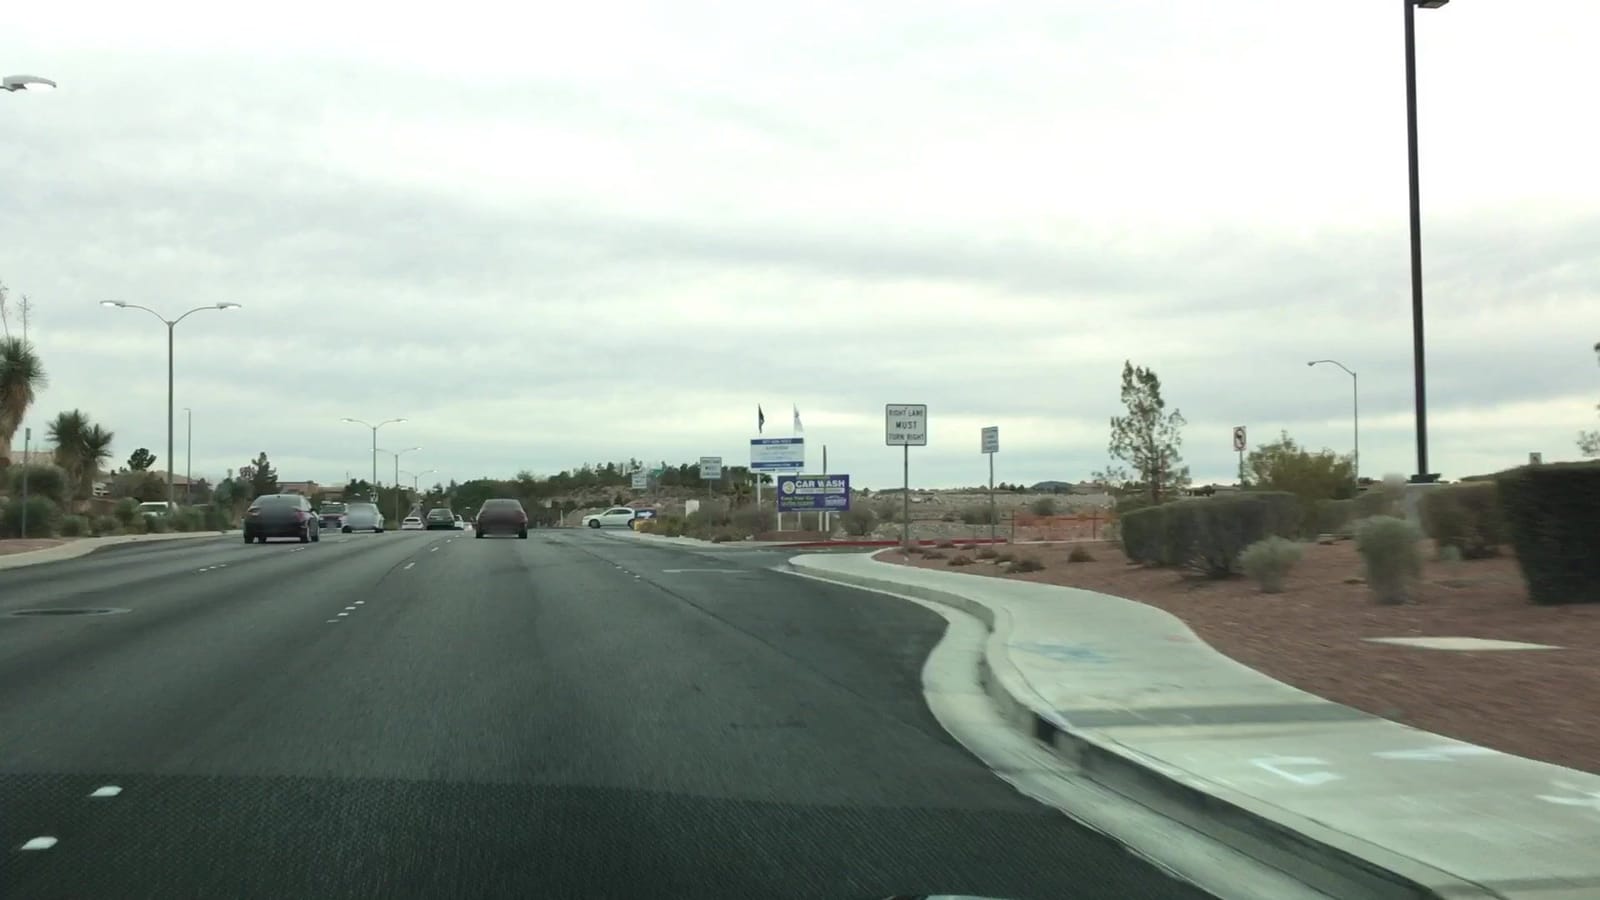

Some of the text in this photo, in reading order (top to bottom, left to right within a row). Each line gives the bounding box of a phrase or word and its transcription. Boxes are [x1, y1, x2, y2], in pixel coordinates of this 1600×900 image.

[889, 409, 923, 417] RIGHT LANE
[896, 421, 917, 429] MUST
[889, 433, 924, 441] TURN RIGHT
[795, 479, 846, 488] CAR WASH
